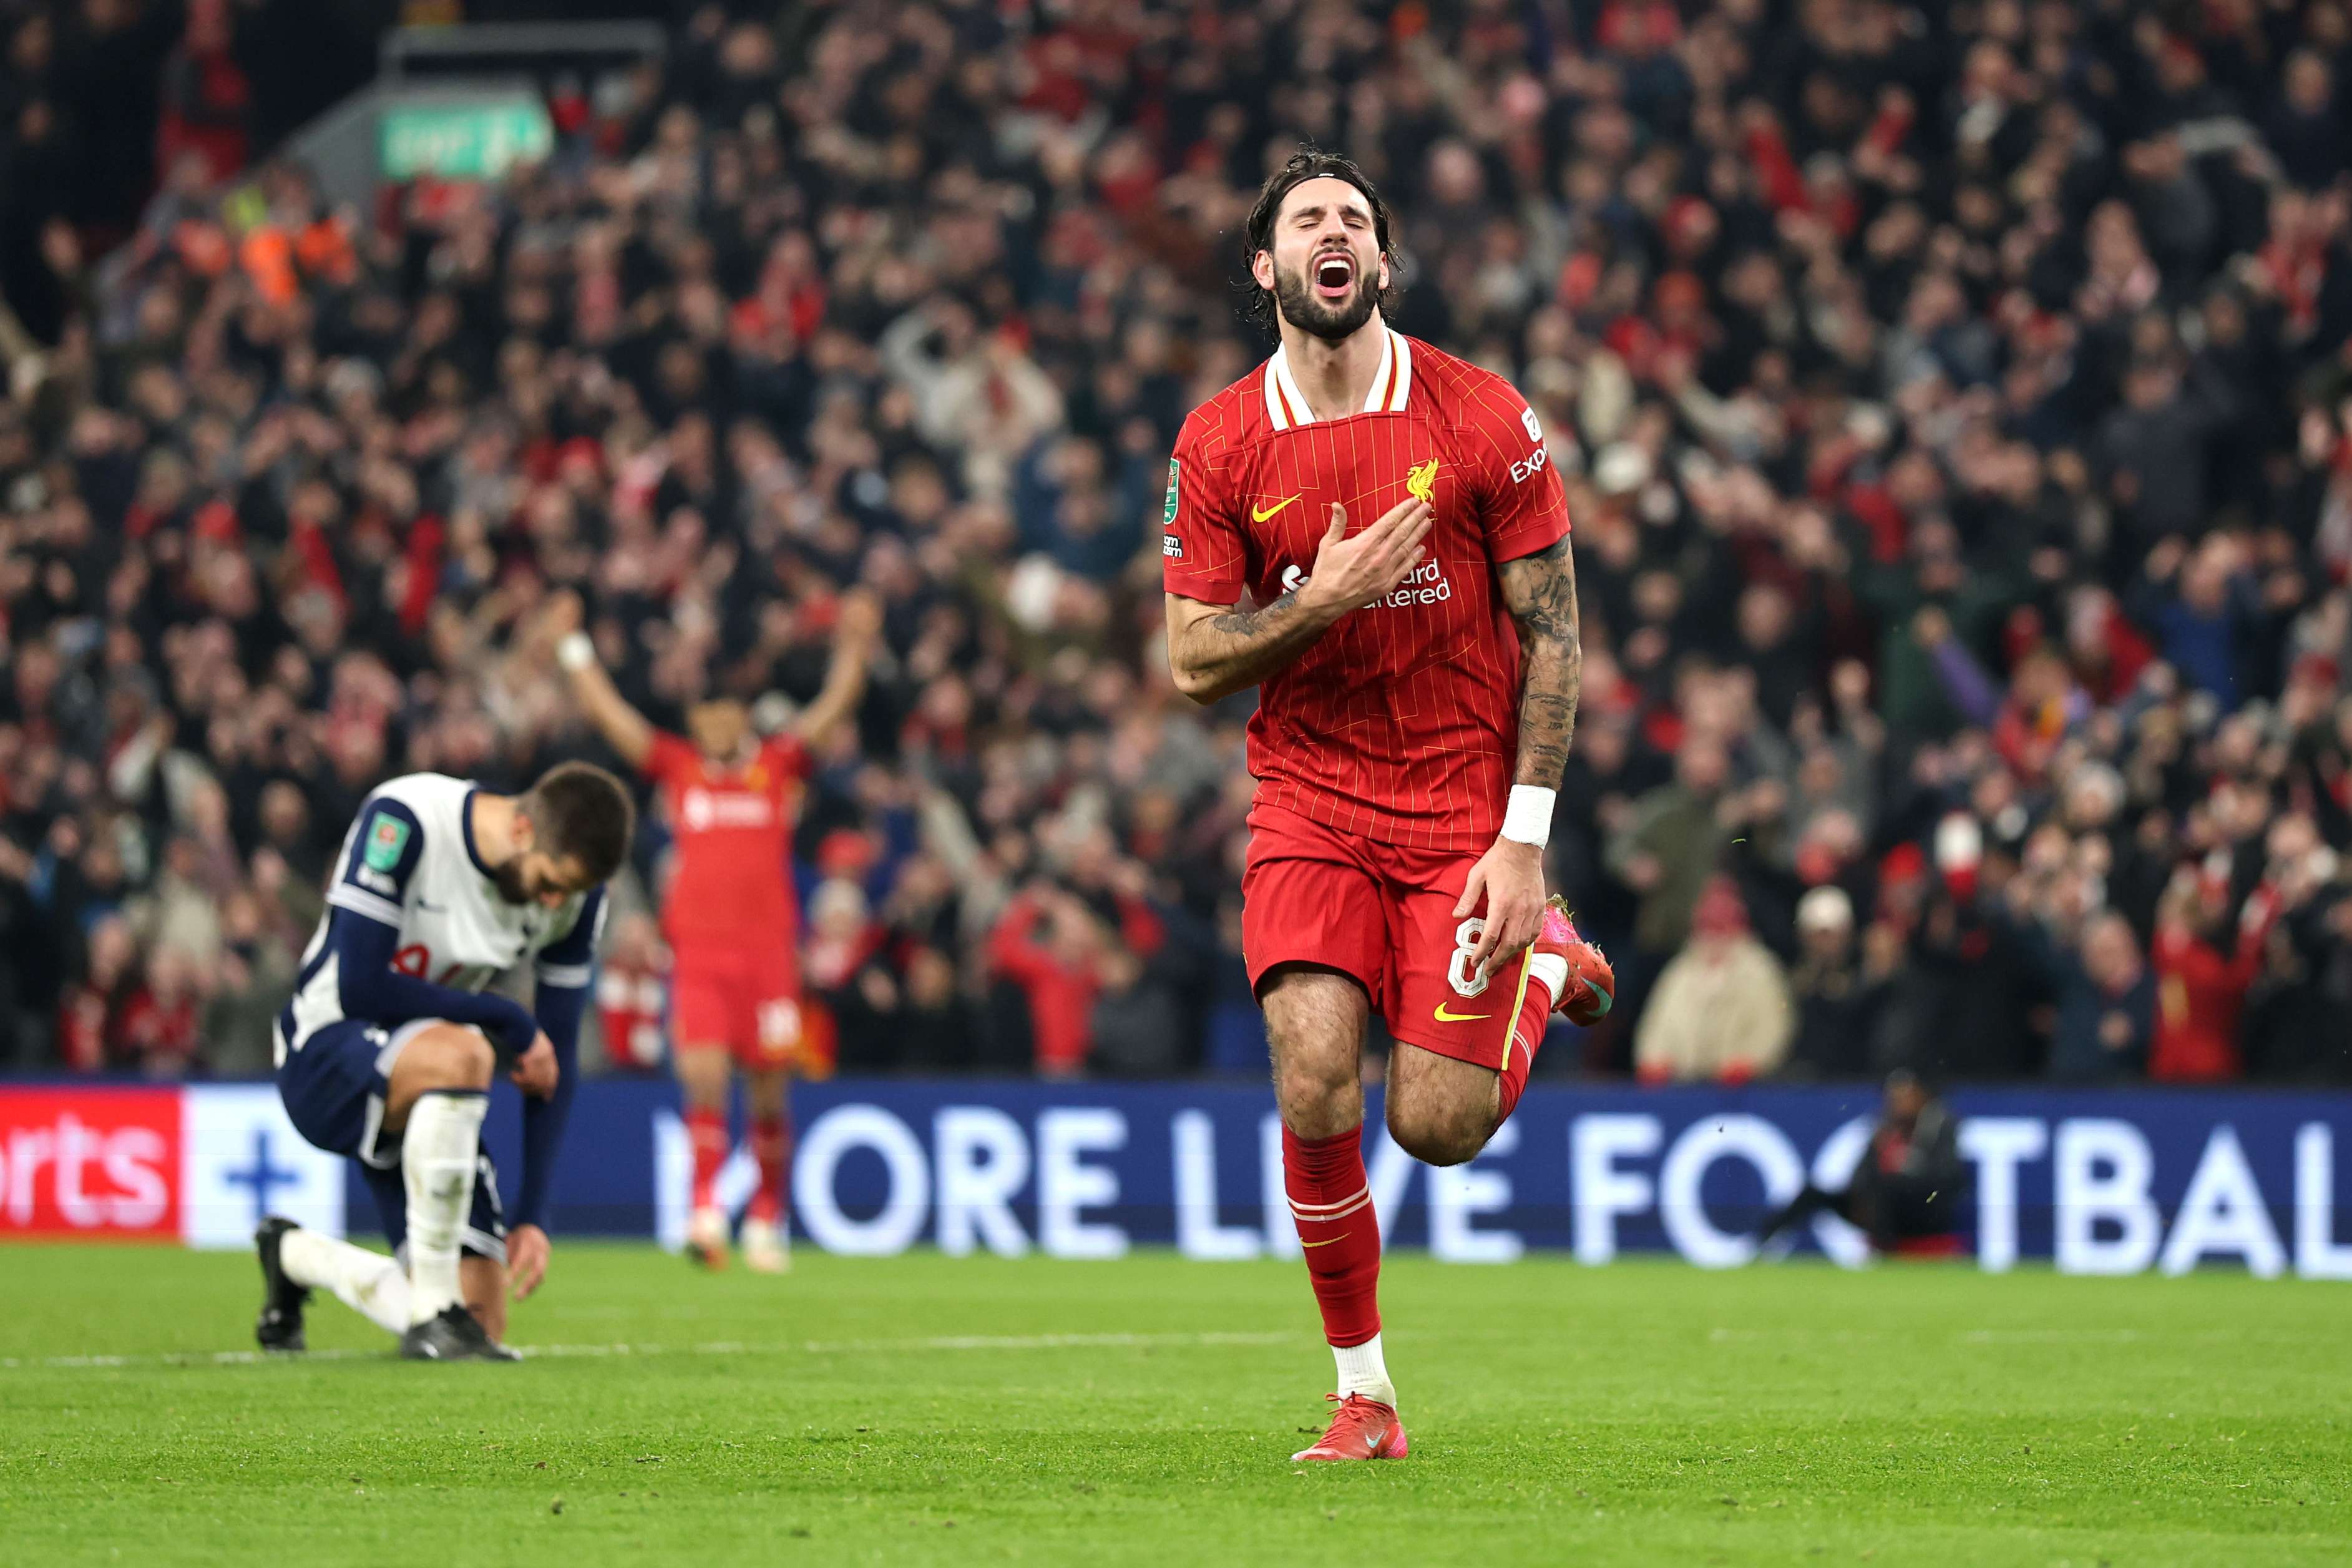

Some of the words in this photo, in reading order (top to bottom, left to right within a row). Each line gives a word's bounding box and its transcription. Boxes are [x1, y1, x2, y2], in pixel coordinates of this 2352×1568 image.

[1510, 439, 1548, 484] Exp
[1447, 917, 1491, 998] 8
[0, 1109, 168, 1228] rts
